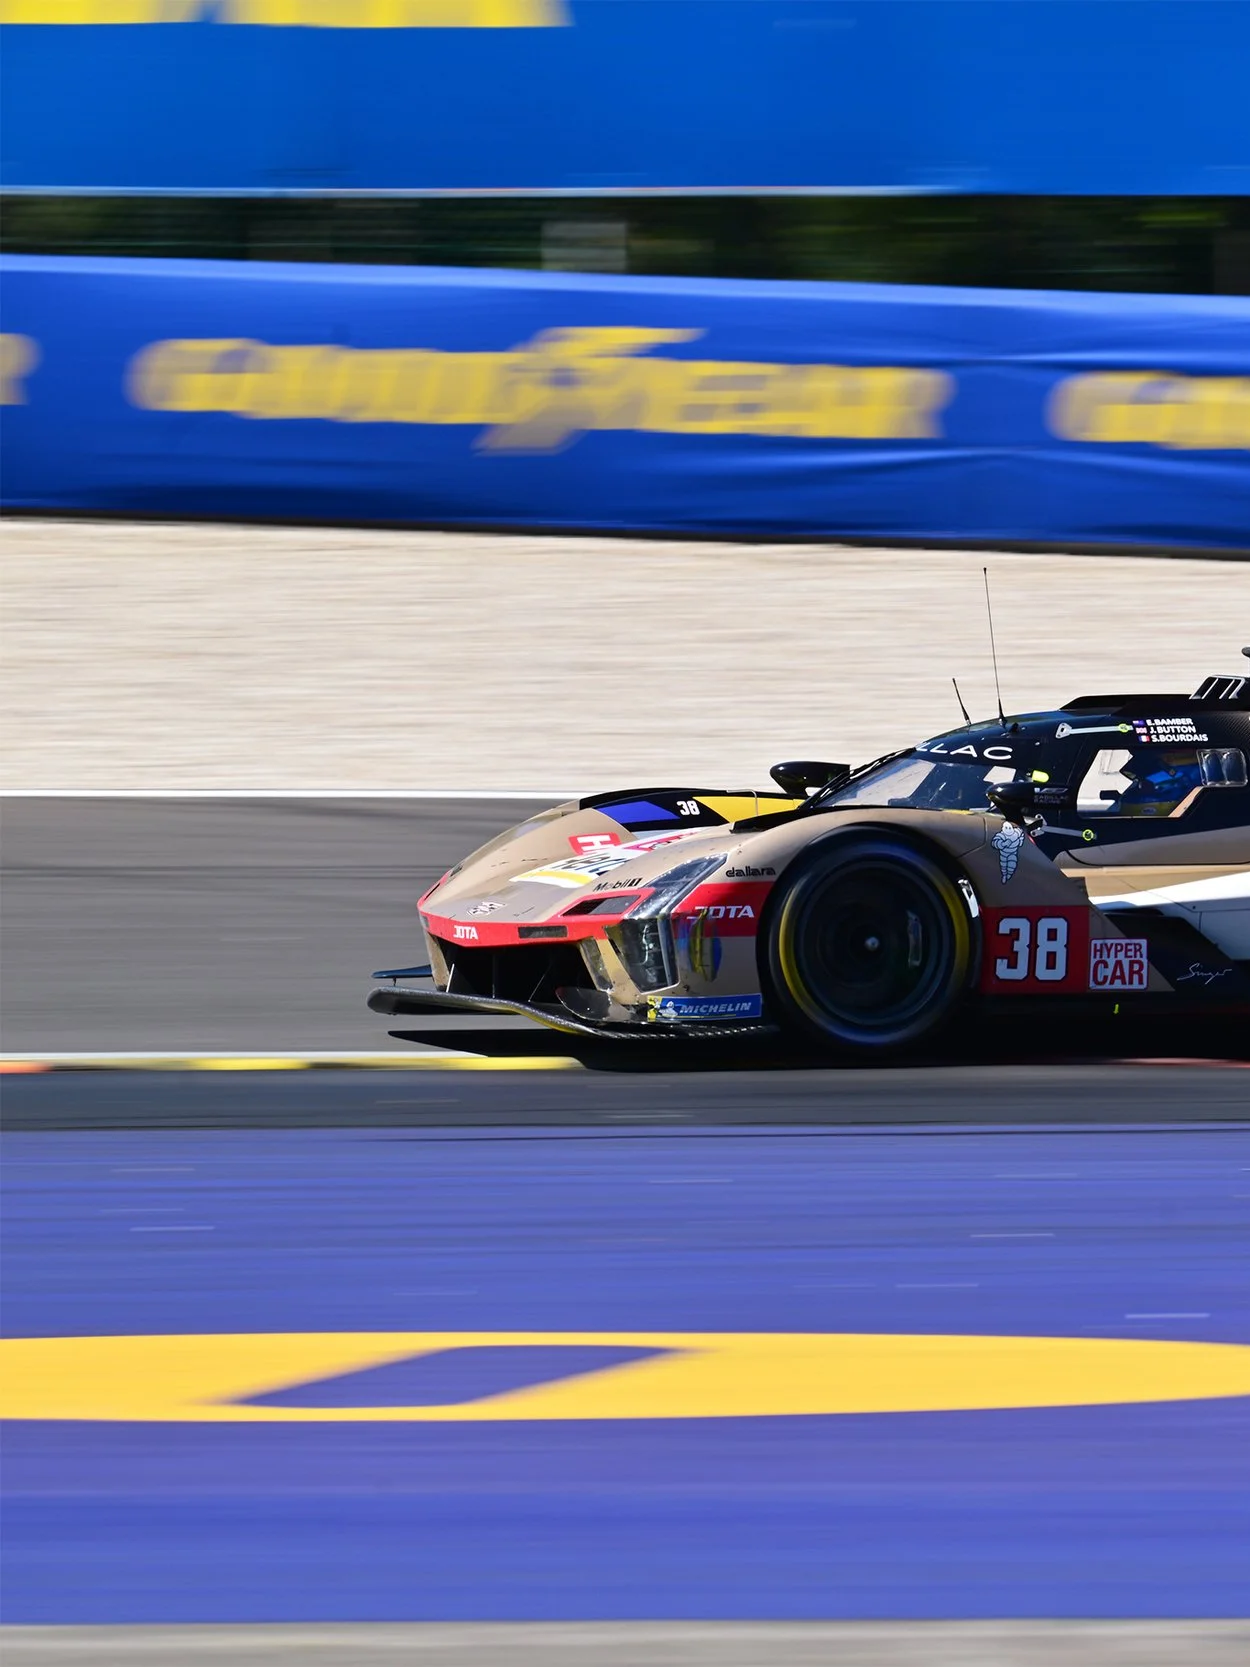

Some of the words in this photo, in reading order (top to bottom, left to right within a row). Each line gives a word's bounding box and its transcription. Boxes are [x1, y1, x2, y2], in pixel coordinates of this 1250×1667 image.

[1145, 718, 1194, 727] E.BAMBER
[1149, 726, 1197, 735] J.BUTTON
[1150, 734, 1209, 743] S.BOURDAIS
[915, 742, 1013, 761] LLAC
[676, 800, 700, 816] 38
[725, 865, 777, 878] dallara
[593, 879, 629, 893] Mobil
[687, 905, 754, 920] JOTA
[453, 924, 479, 940] JOTA
[995, 916, 1069, 982] 38
[1093, 943, 1143, 959] HYPER
[1092, 959, 1145, 986] CAR
[679, 1002, 752, 1015] MICHELIN
